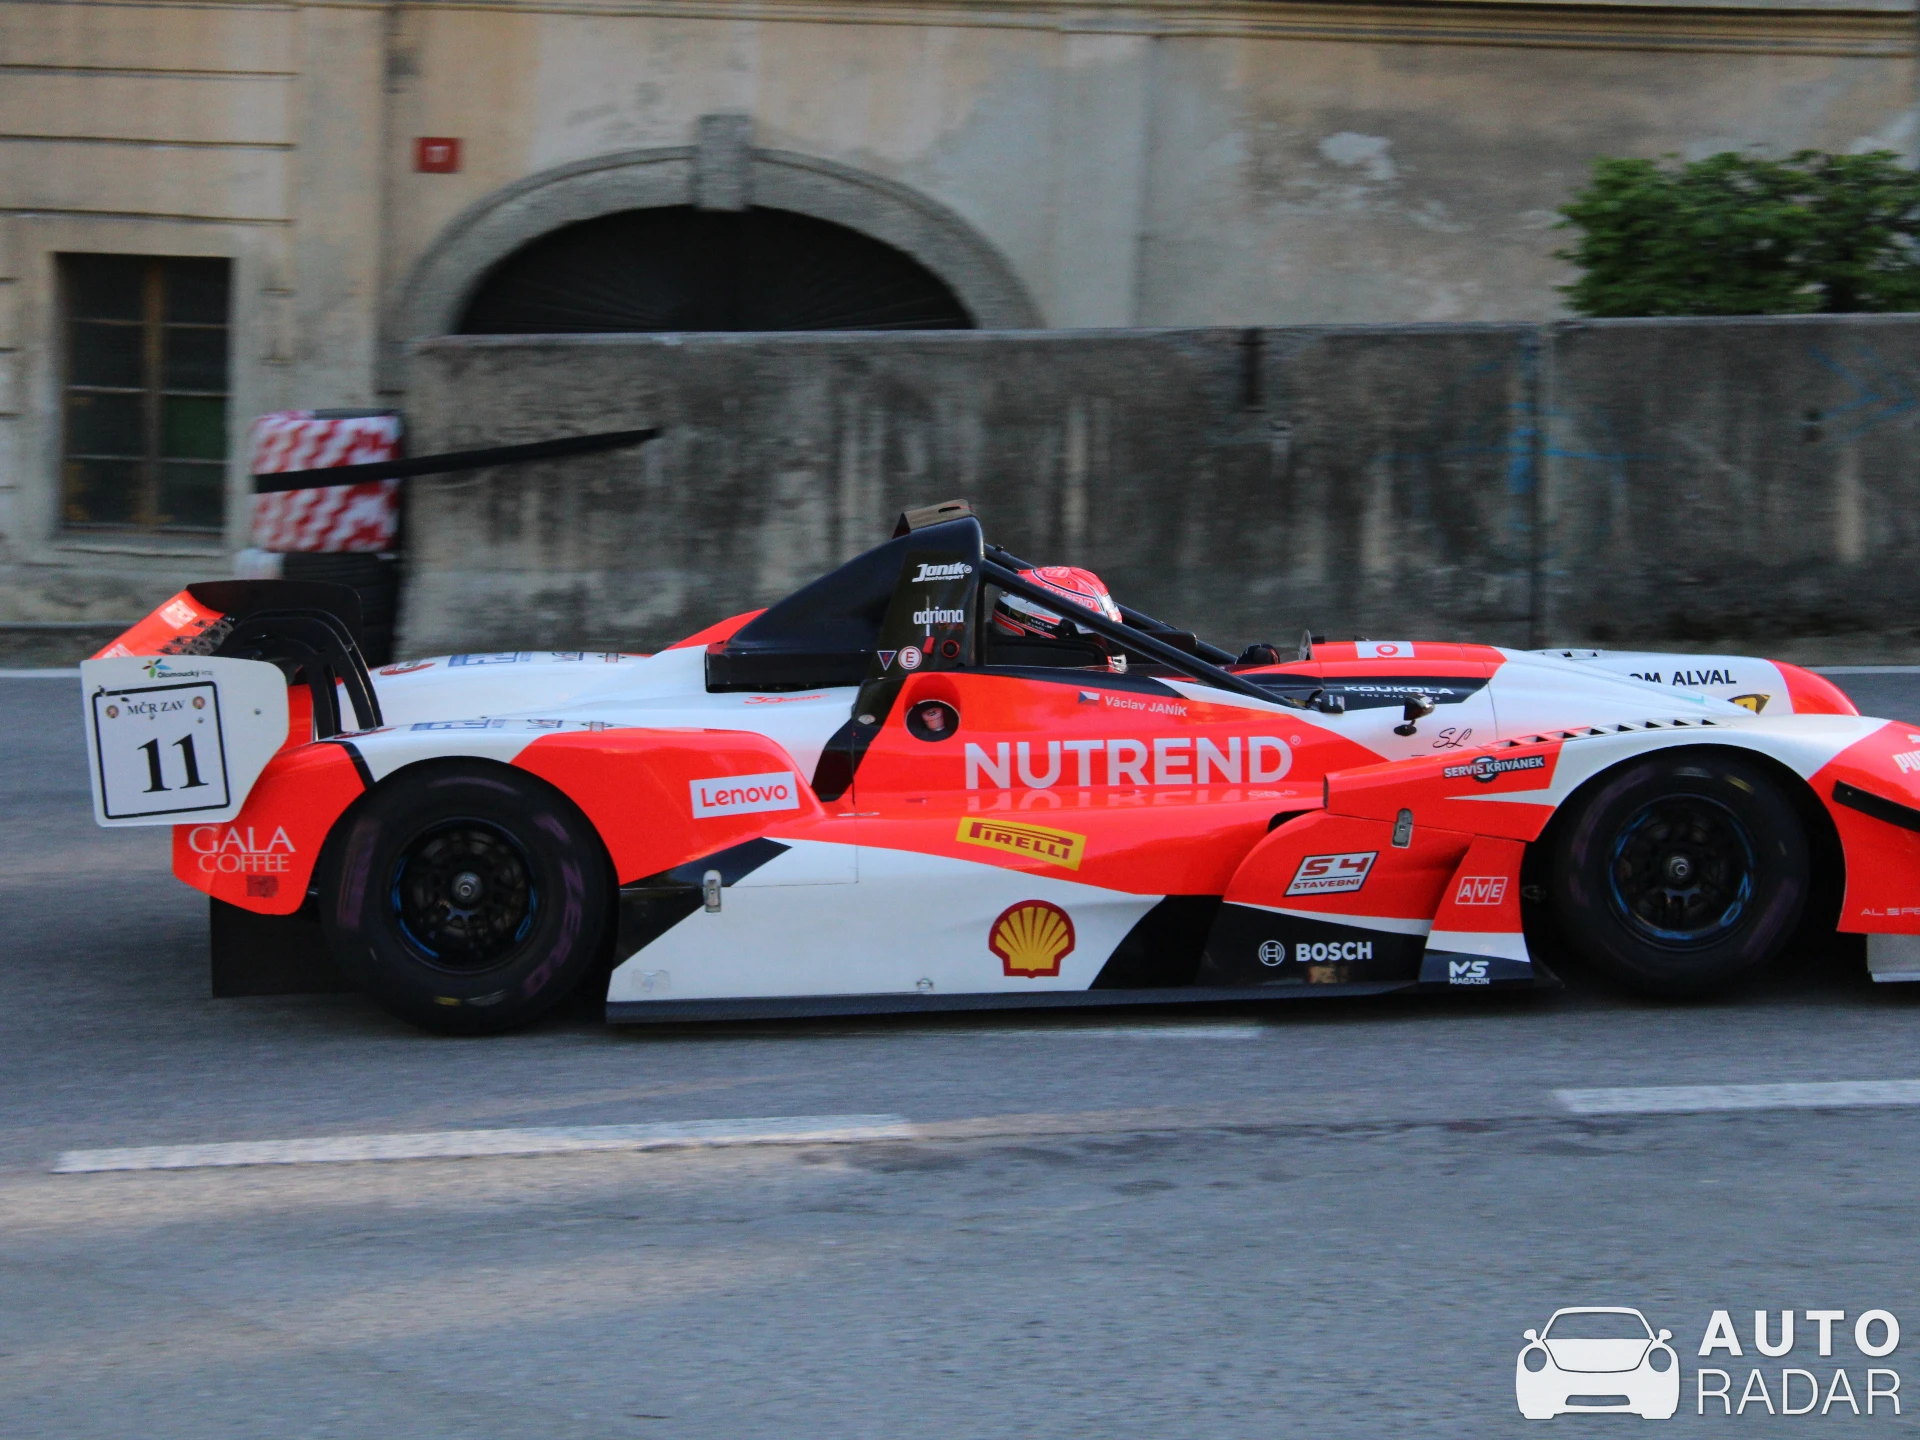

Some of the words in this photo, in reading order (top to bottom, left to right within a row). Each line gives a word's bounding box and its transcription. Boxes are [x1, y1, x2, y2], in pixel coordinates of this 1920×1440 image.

[1043, 585, 1094, 609] REND
[913, 606, 964, 625] adriana
[1672, 669, 1737, 686] ALVAL
[1344, 686, 1455, 695] KOUKOLA
[127, 702, 157, 715] MČR
[160, 700, 185, 712] ZAV
[1105, 696, 1146, 711] Václav
[1148, 701, 1188, 717] JANÍK
[137, 733, 209, 793] 11
[965, 735, 1293, 790] NUTREND
[1444, 764, 1485, 777] SERVIS
[1486, 757, 1544, 772] KŘIVÁNEK
[701, 784, 788, 807] Lenovo
[188, 826, 296, 854] GALA
[969, 822, 1073, 860] PIRELLI
[198, 853, 290, 873] COFFEE
[1460, 883, 1502, 898] AVE
[1296, 941, 1372, 962] BOSCH
[1449, 960, 1490, 978] MS
[1449, 977, 1490, 985] MAGAZIN
